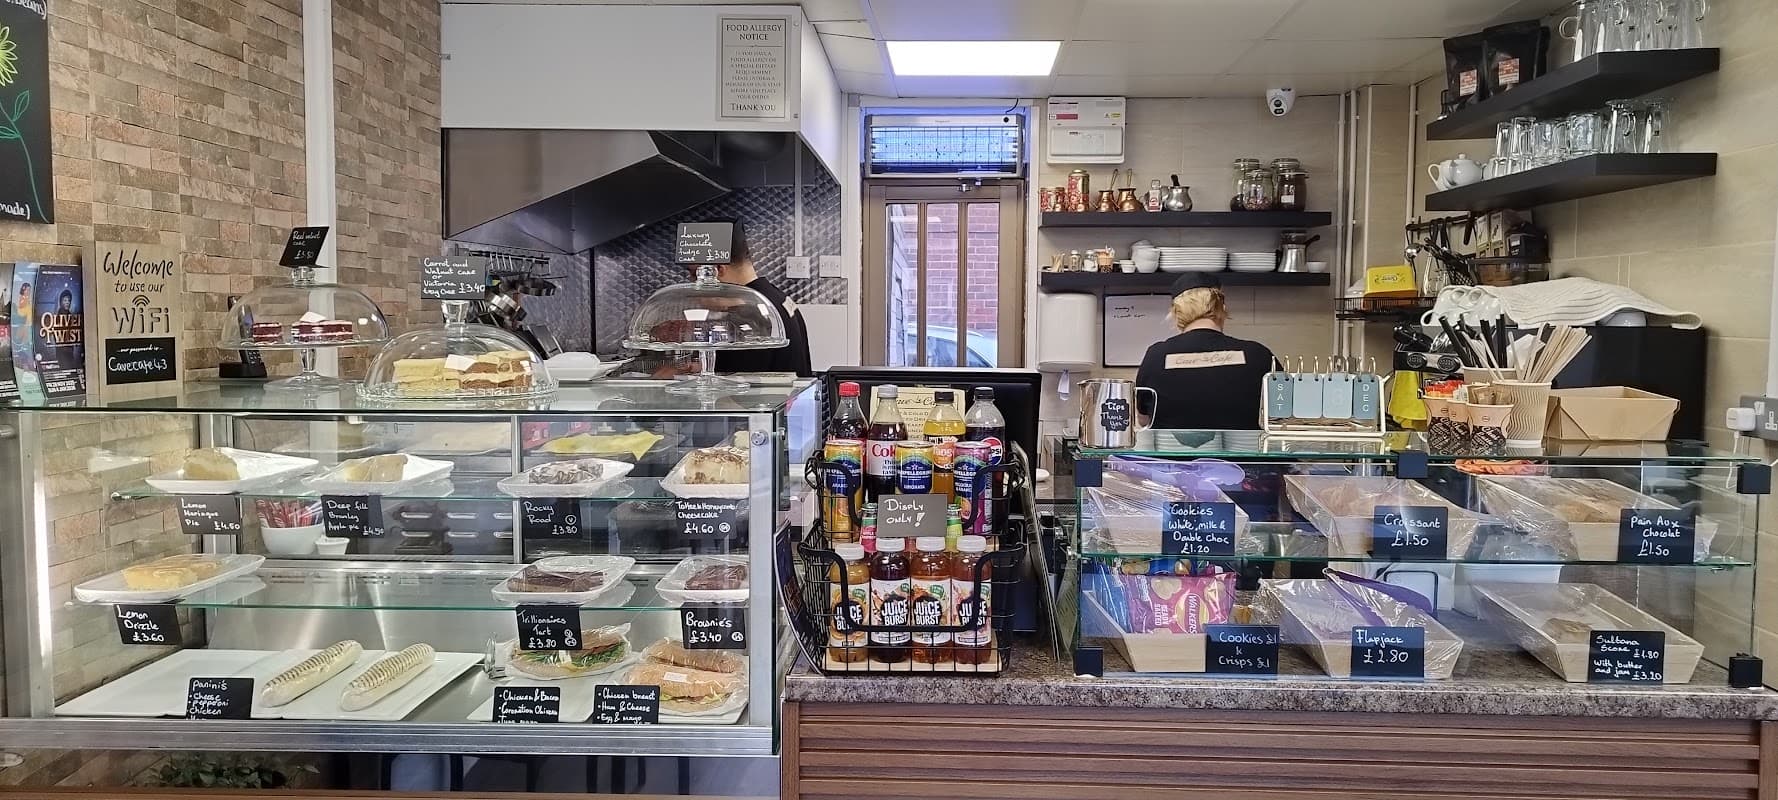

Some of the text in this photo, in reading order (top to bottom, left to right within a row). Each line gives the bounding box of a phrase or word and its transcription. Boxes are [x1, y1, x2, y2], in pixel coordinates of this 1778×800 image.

[730, 103, 758, 111] THANK
[104, 249, 174, 279] Welcome
[424, 258, 450, 267] Carrot
[114, 280, 164, 292] to use our
[458, 282, 486, 294] £3.40
[112, 307, 170, 334] WiFi
[1105, 402, 1125, 412] Tips
[181, 497, 206, 508] Lemon
[326, 500, 351, 510] Deep
[1171, 504, 1214, 516] Cookies
[527, 514, 551, 524] Road
[1384, 513, 1440, 528] Croissant
[1657, 515, 1680, 528] Aux
[552, 524, 578, 535] £3.80
[684, 522, 714, 534] £4.60
[1642, 527, 1680, 538] Chocolat
[1391, 530, 1429, 546] £1.50
[1181, 542, 1210, 554] £1.20
[1637, 539, 1669, 556] £1.50
[116, 605, 148, 619] Lemon
[881, 600, 908, 616] JUICE
[914, 601, 941, 615] JUICE
[1188, 594, 1198, 634] WALKERS
[124, 619, 159, 630] Drizzle
[686, 611, 732, 628] Brownie's
[884, 613, 907, 626] BURST
[916, 614, 941, 625] BURST
[533, 624, 551, 635] Tart
[133, 632, 164, 642] £3.60
[528, 637, 557, 649] £3.80
[689, 630, 722, 644] £3.40
[1220, 631, 1277, 644] Cookies £1
[1356, 629, 1404, 648] Flapjack
[1596, 635, 1640, 646] Sultana
[1633, 648, 1659, 659] £1.80
[1218, 655, 1253, 668] Crisps
[1617, 660, 1643, 669] butter
[1614, 667, 1630, 678] jam
[1632, 671, 1662, 680] £3.20
